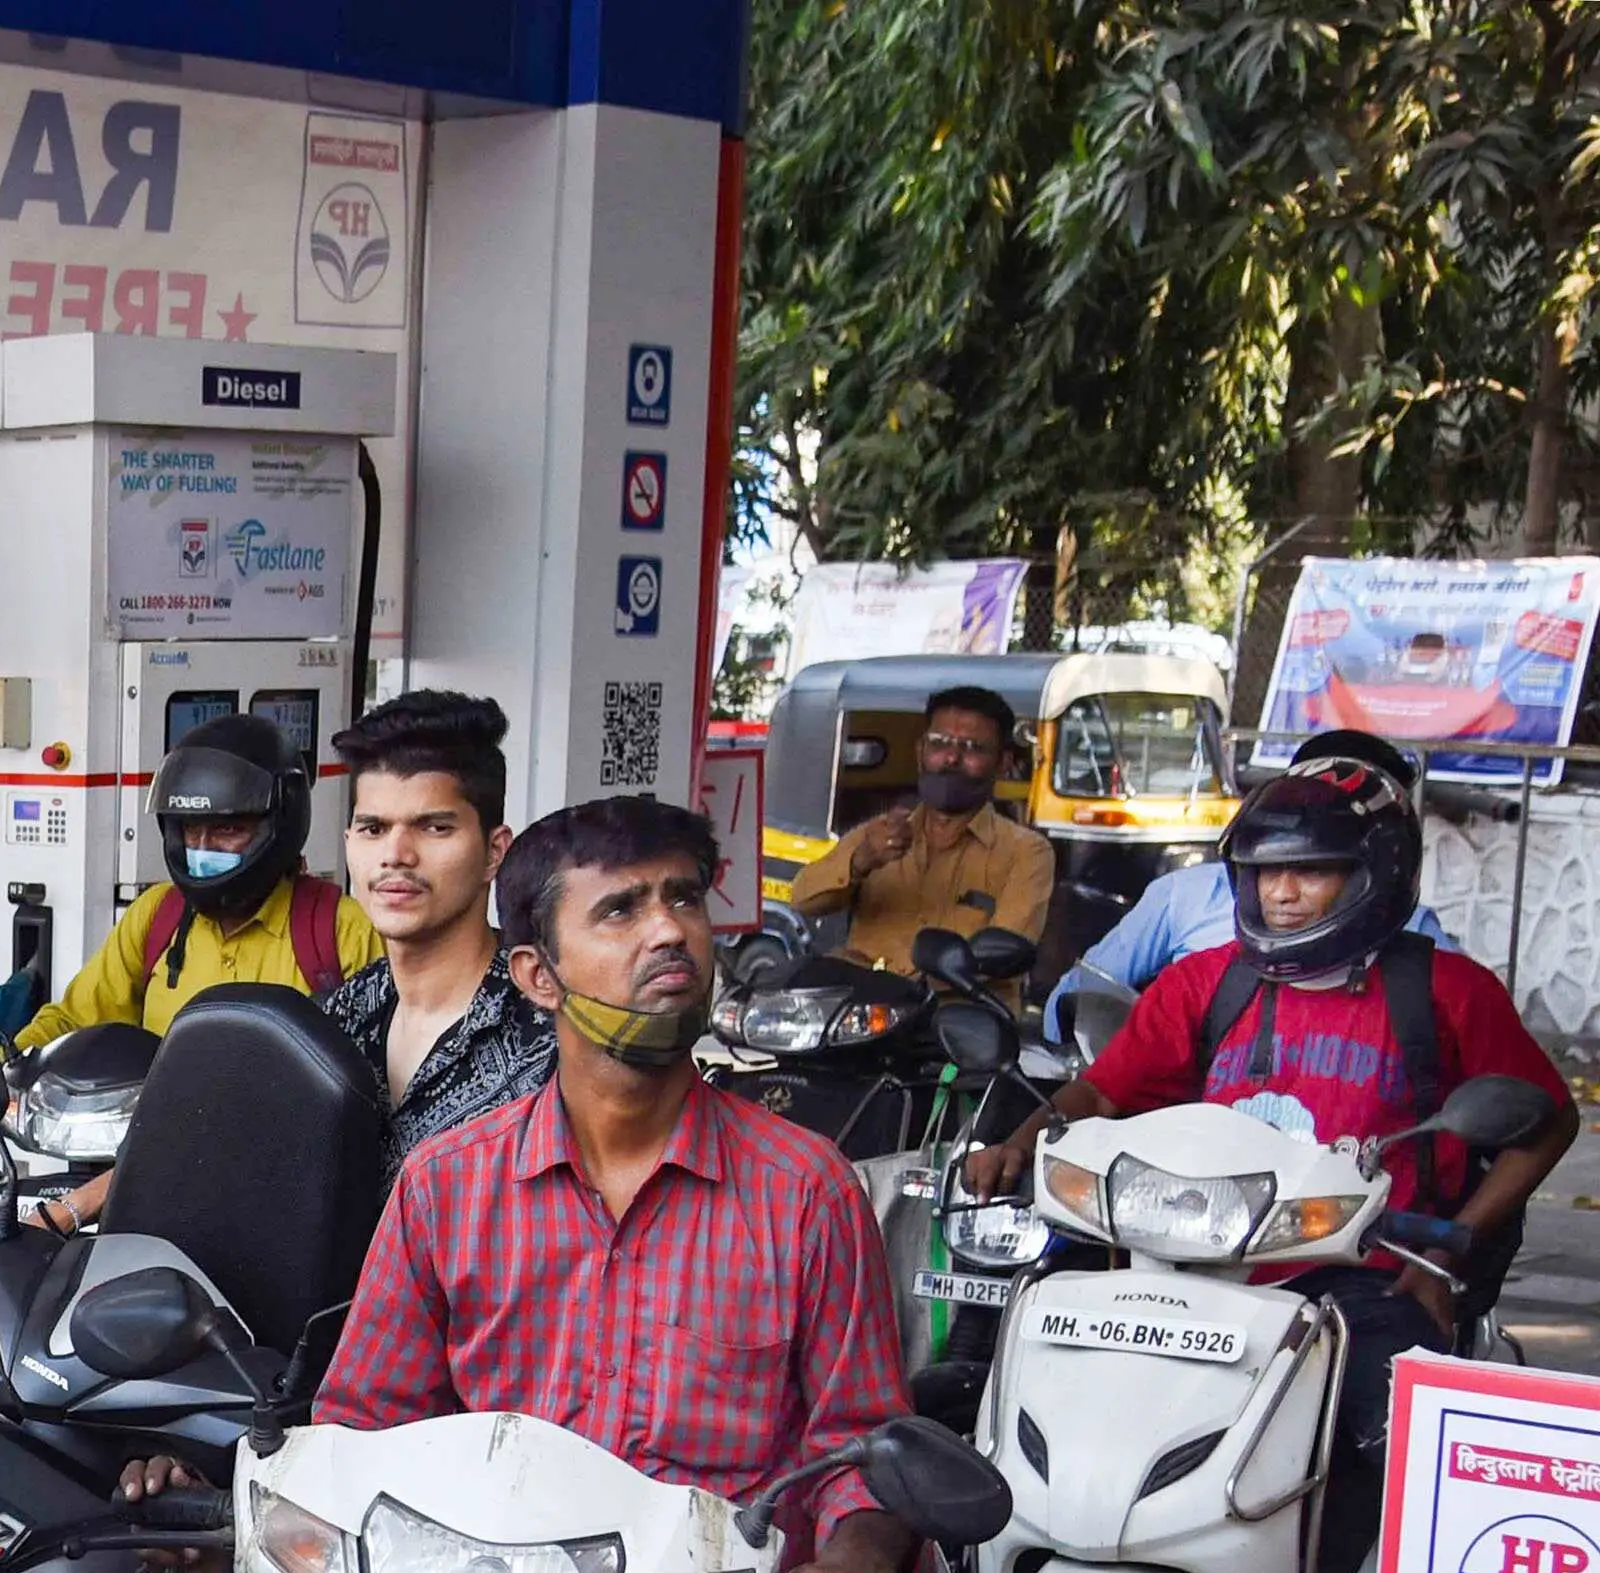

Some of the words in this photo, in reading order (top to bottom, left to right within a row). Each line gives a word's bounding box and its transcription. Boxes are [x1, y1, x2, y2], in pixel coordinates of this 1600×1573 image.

[217, 376, 287, 401] Diesel
[121, 452, 148, 468] THE
[152, 452, 215, 471] SMARTER
[121, 475, 152, 493] WAY
[156, 476, 173, 491] OF
[179, 475, 237, 494] FUELING!
[120, 598, 140, 610] CALL
[931, 1277, 953, 1295] MH
[1114, 1293, 1190, 1309] HONDA
[1180, 1330, 1234, 1354] 5926
[21, 1355, 69, 1391] HONDA
[1455, 1446, 1544, 1486] हिन्दुस्तान
